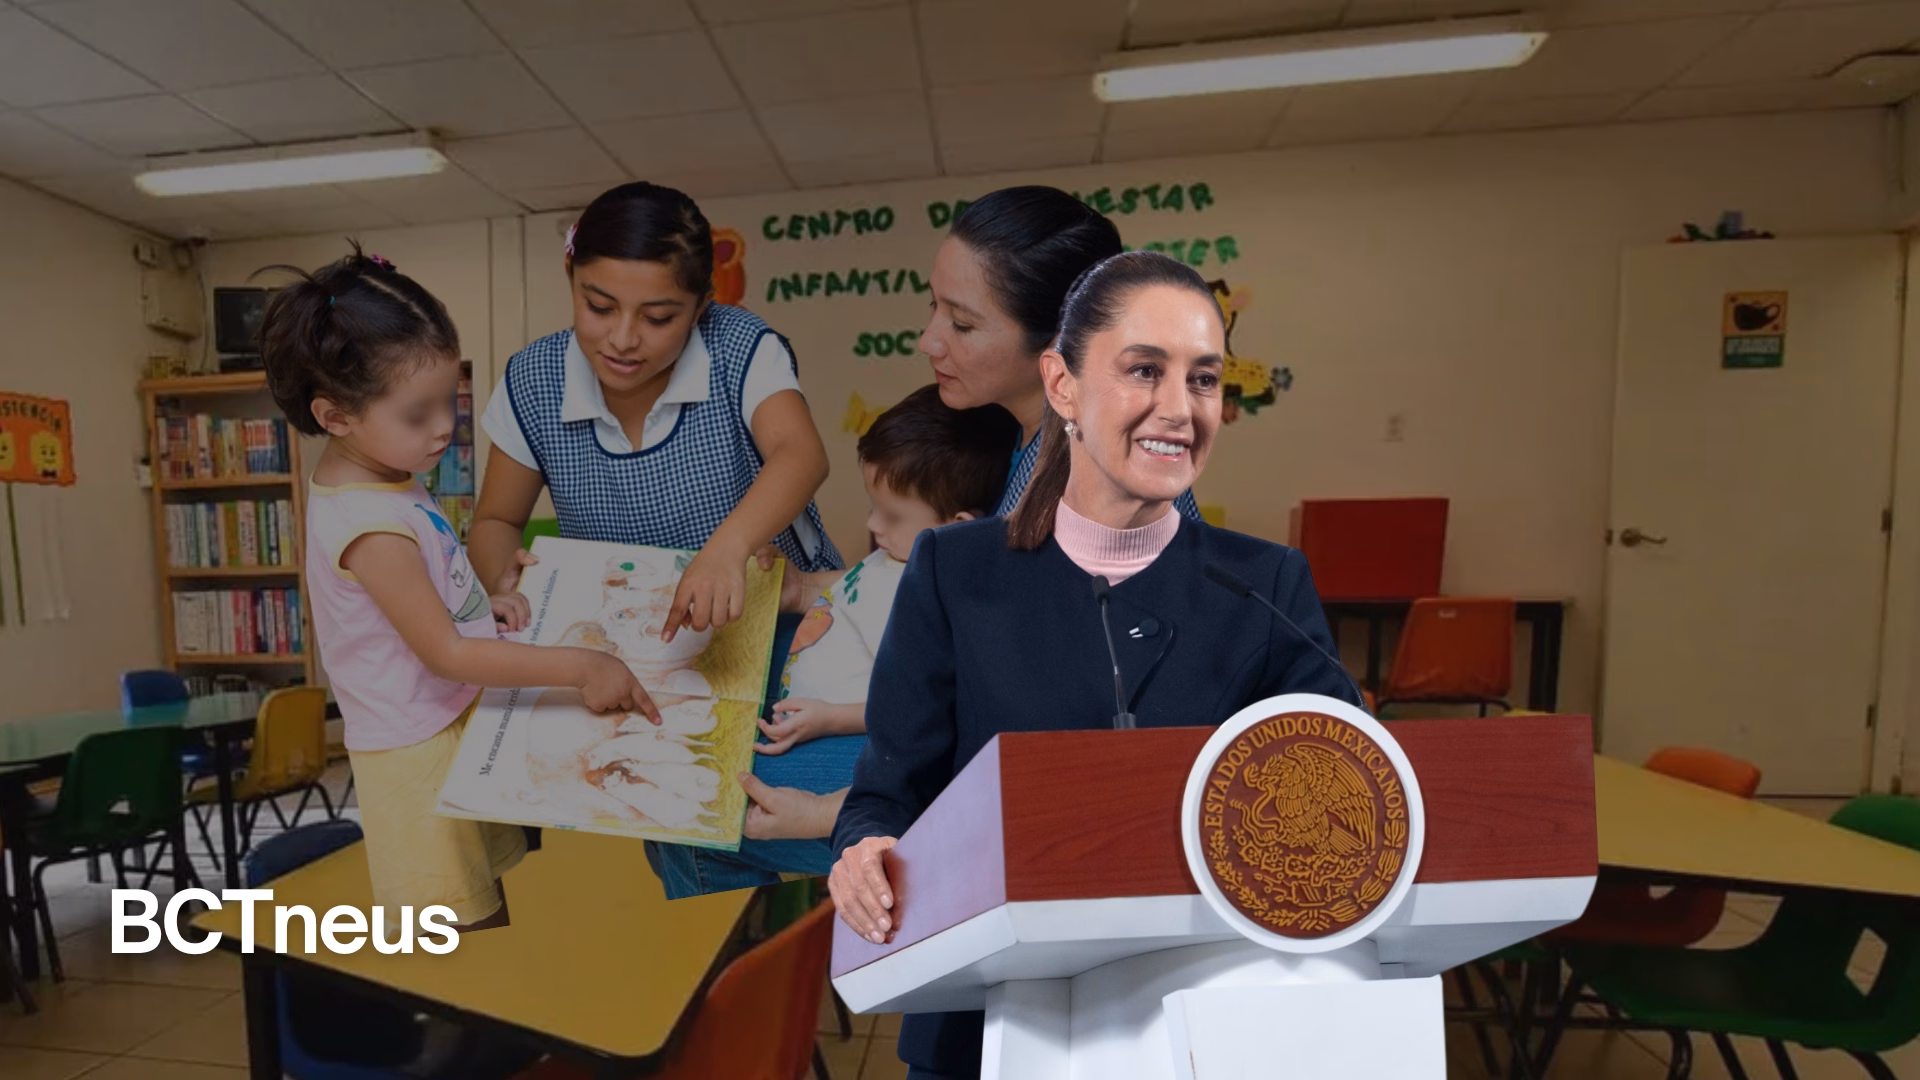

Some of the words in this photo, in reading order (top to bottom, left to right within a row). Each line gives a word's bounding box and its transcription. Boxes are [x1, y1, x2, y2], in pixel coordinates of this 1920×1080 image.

[762, 205, 894, 241] CENTRO
[766, 268, 930, 303] INFANTIL
[853, 329, 924, 358] SOC
[479, 760, 494, 777] Me
[488, 731, 506, 764] encanta
[1204, 739, 1253, 828] ESTADOS
[1249, 716, 1322, 749] UNIDOS
[1323, 719, 1405, 820] MEXICANOS
